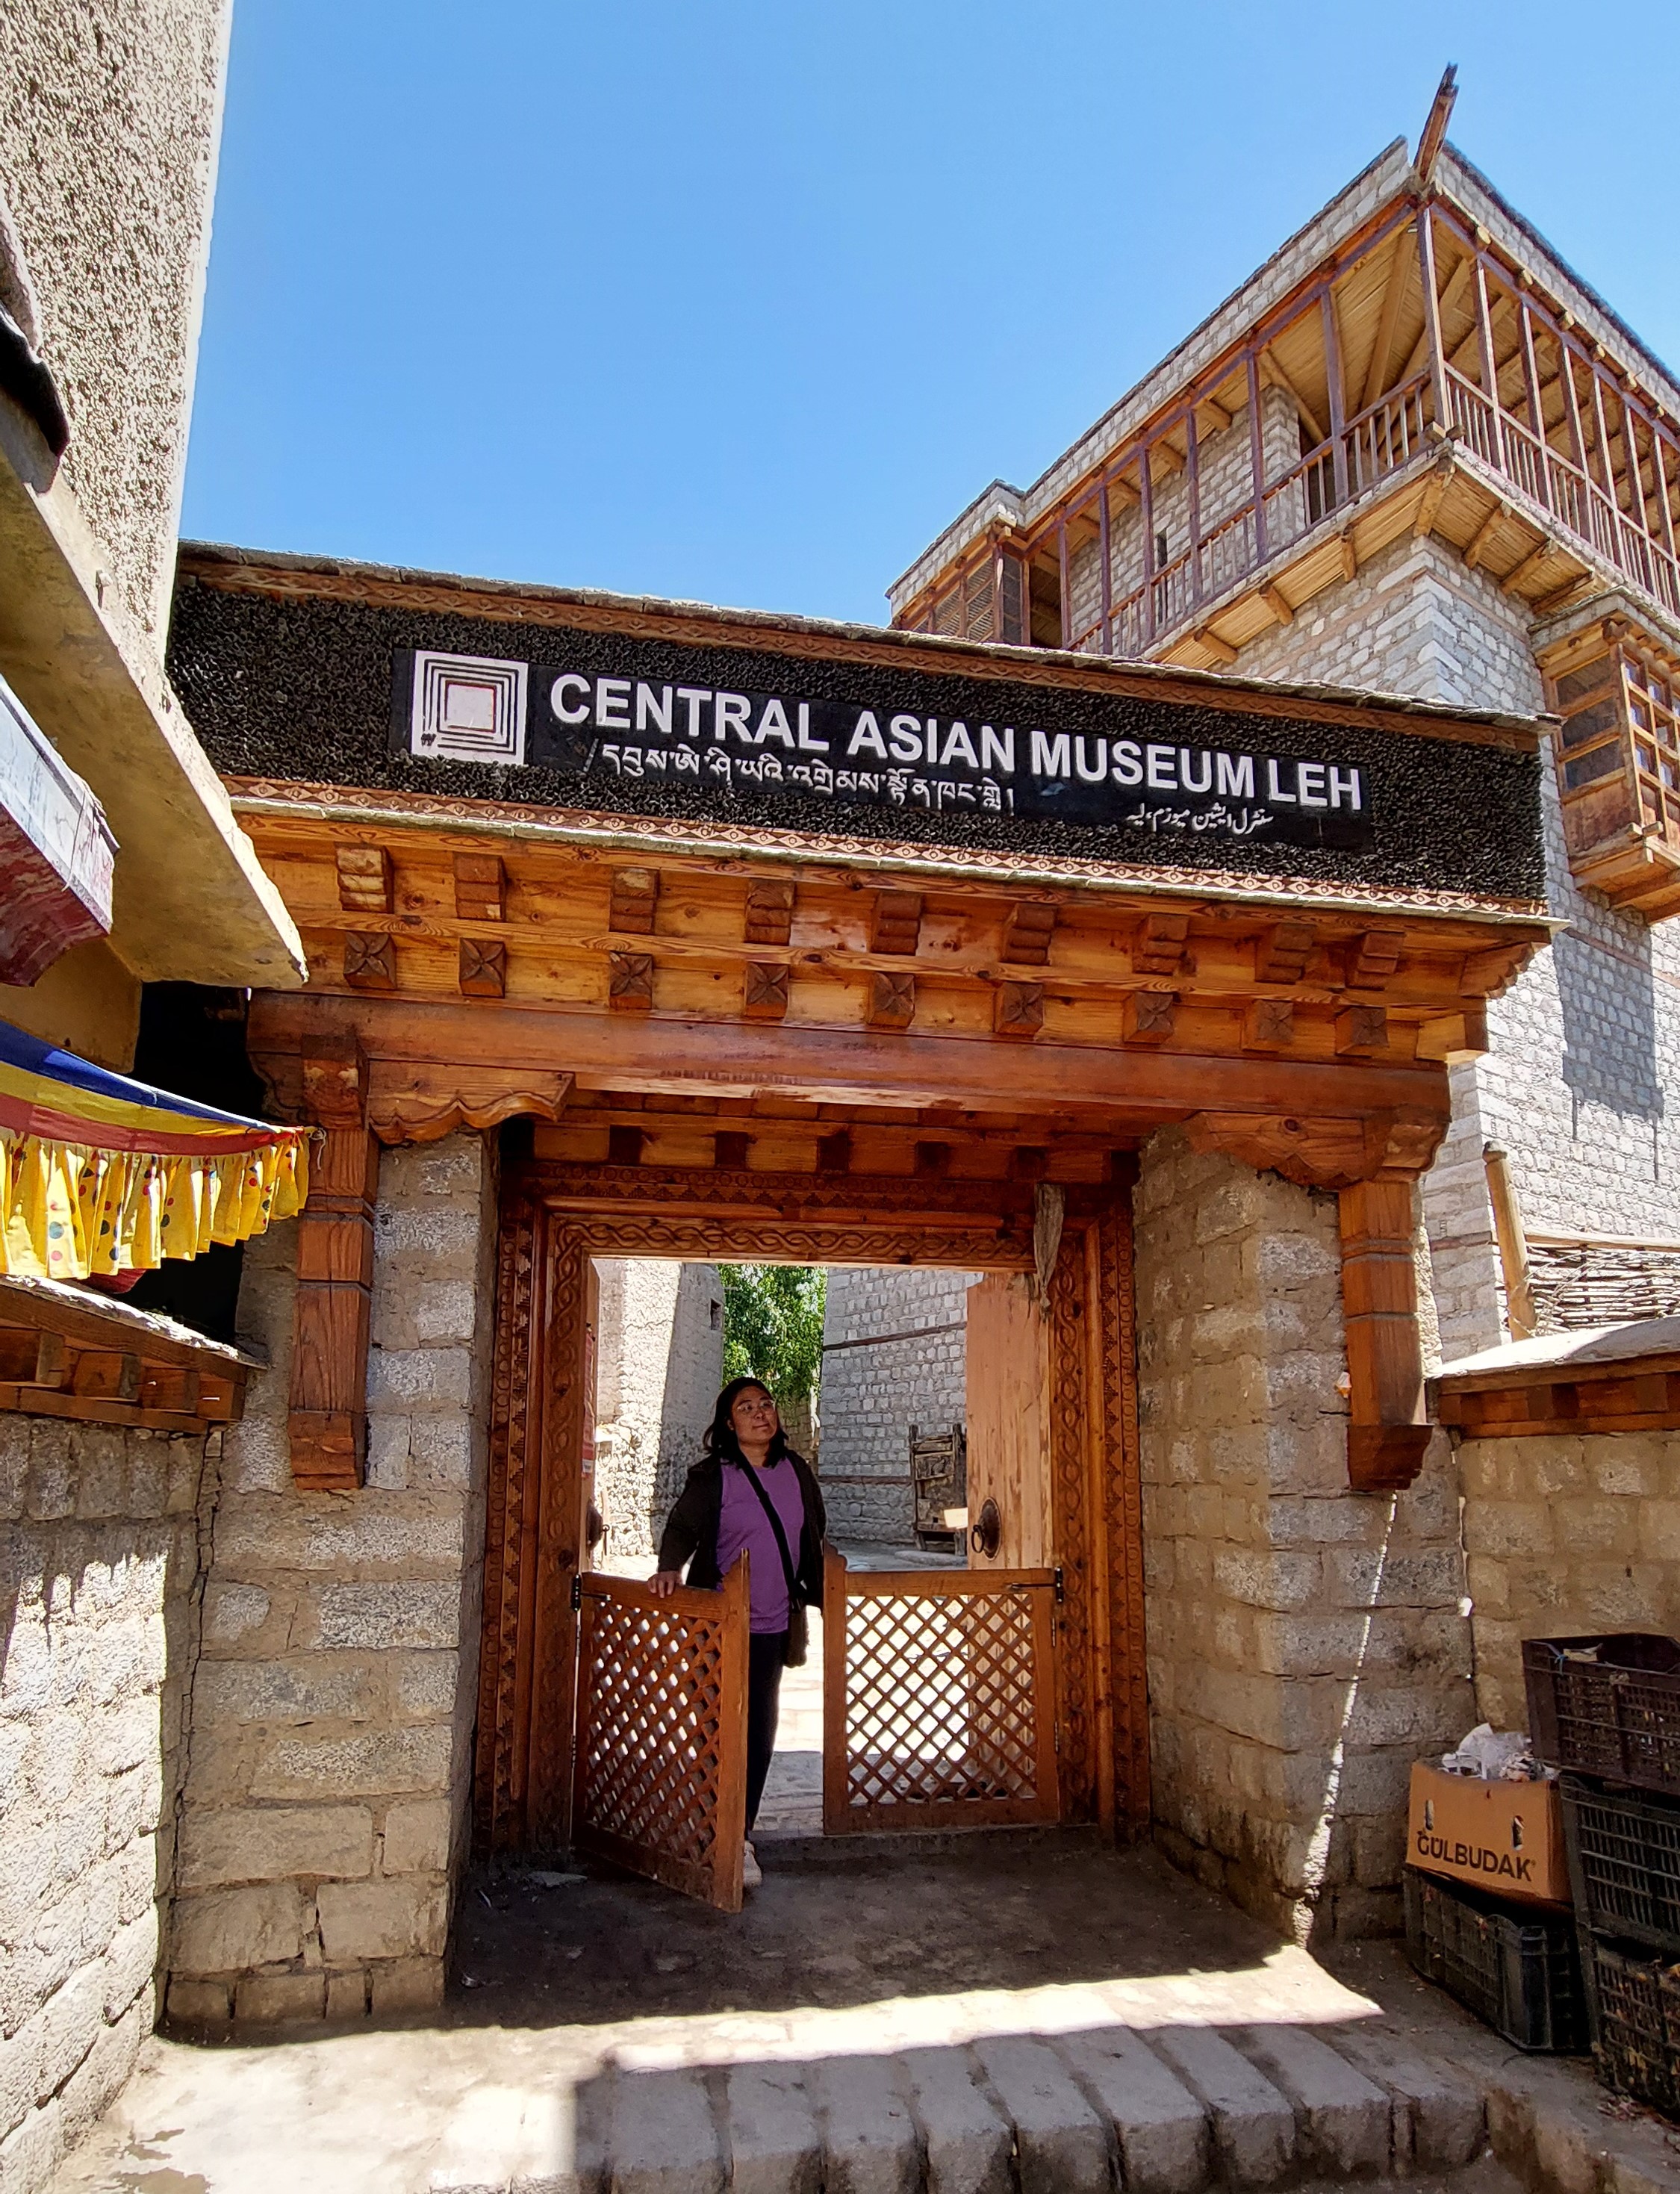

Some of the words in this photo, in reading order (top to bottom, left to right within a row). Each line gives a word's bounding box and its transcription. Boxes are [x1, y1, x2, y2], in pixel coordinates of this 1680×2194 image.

[550, 674, 831, 752] CENTRAL
[847, 711, 1015, 772] ASIAN
[1030, 731, 1255, 798] MUSEUM
[1269, 758, 1363, 812] LEH
[1416, 1835, 1532, 1882] GÜLBUDAK
